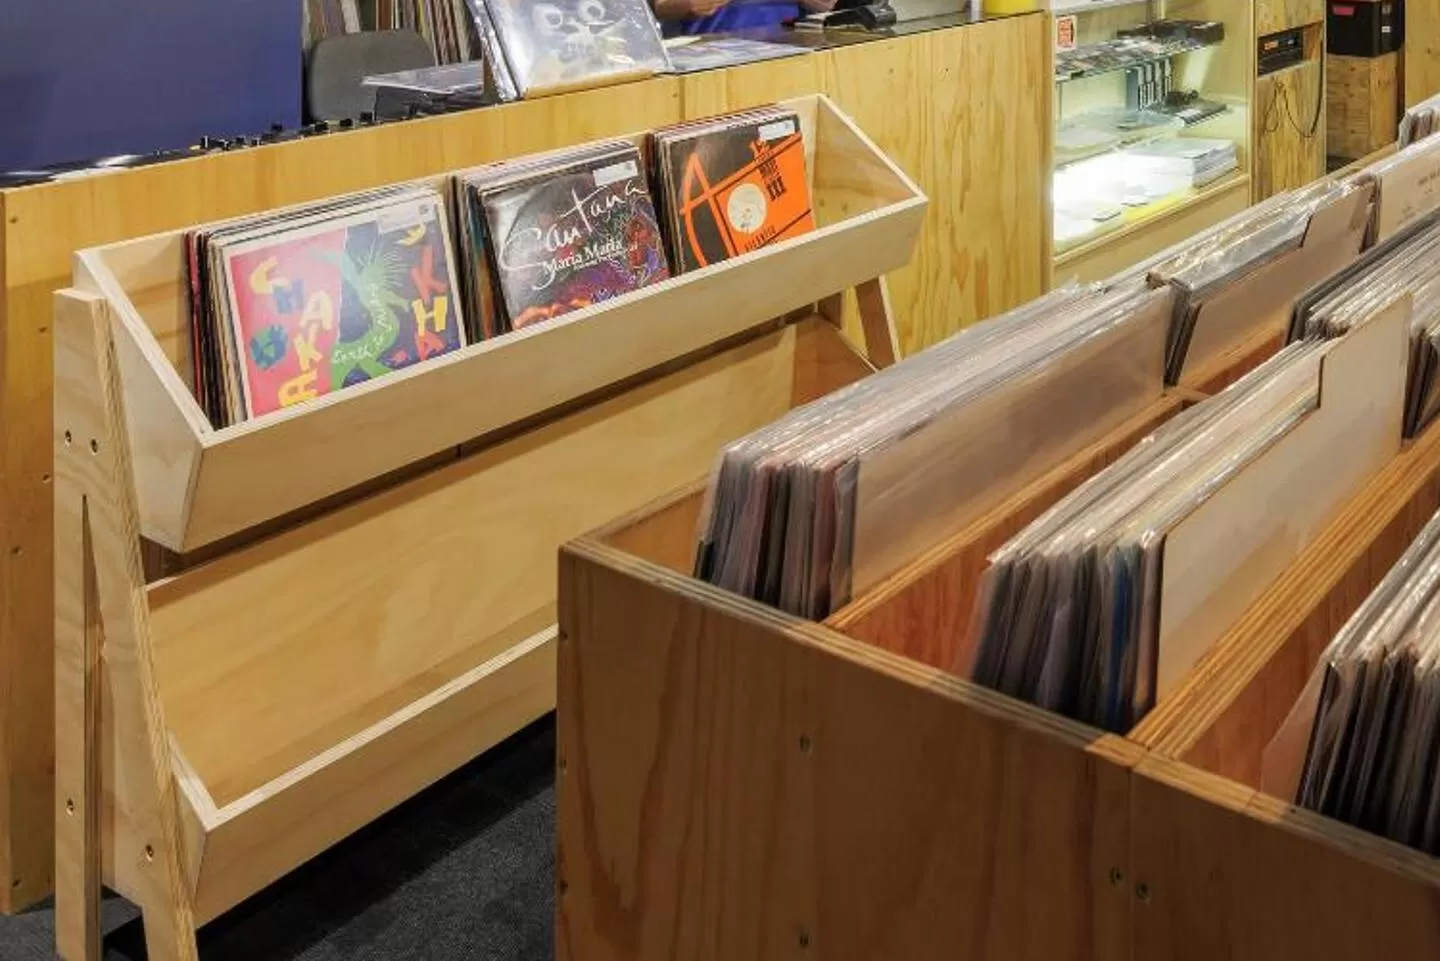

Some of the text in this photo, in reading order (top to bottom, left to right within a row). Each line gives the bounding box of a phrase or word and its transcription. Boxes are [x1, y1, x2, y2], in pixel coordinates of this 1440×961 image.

[499, 179, 647, 291] Santana
[543, 252, 583, 275] Maria
[584, 239, 622, 262] Maria
